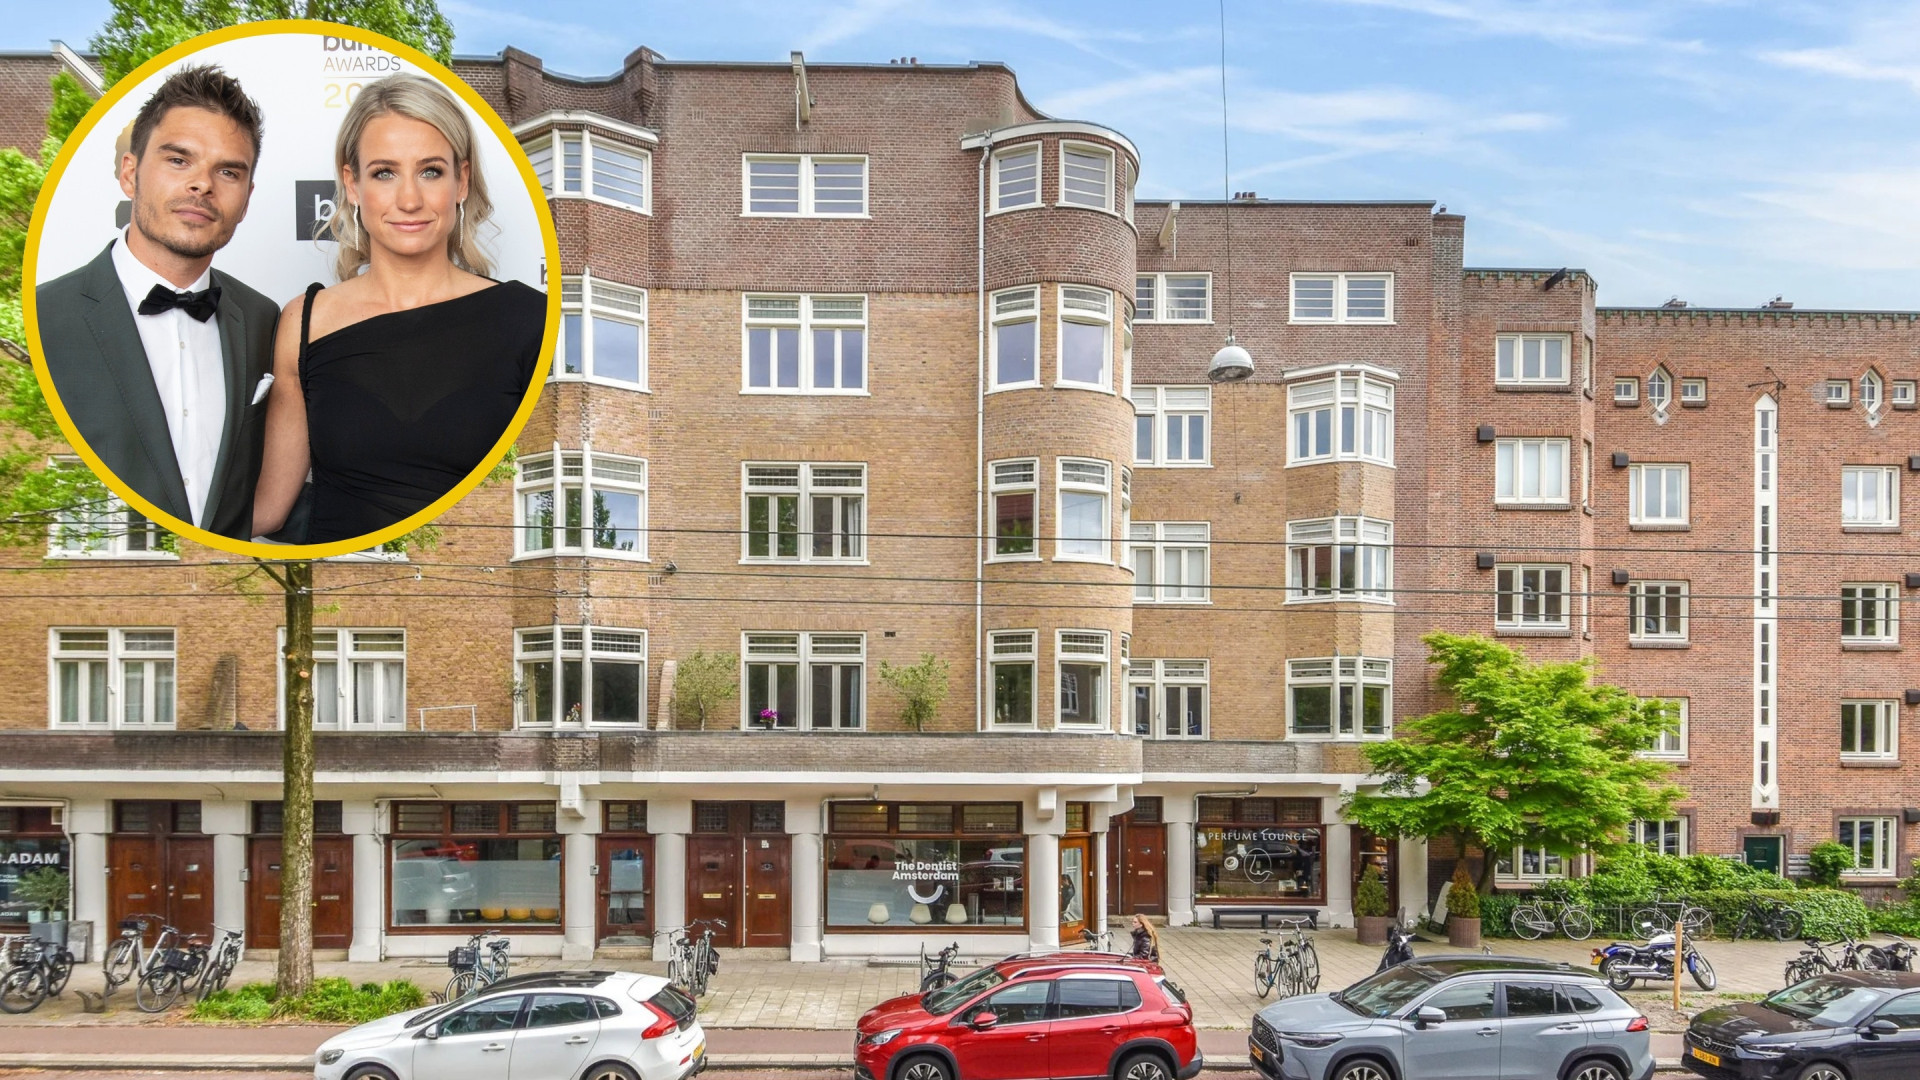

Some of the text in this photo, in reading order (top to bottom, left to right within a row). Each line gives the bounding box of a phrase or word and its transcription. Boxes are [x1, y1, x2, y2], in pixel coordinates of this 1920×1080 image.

[323, 56, 401, 71] AWARDS
[1208, 832, 1307, 840] PERFUME LOUNGE
[0, 852, 60, 864] .ADAM
[894, 860, 957, 870] The Dentist
[892, 871, 959, 880] Amsterdam
